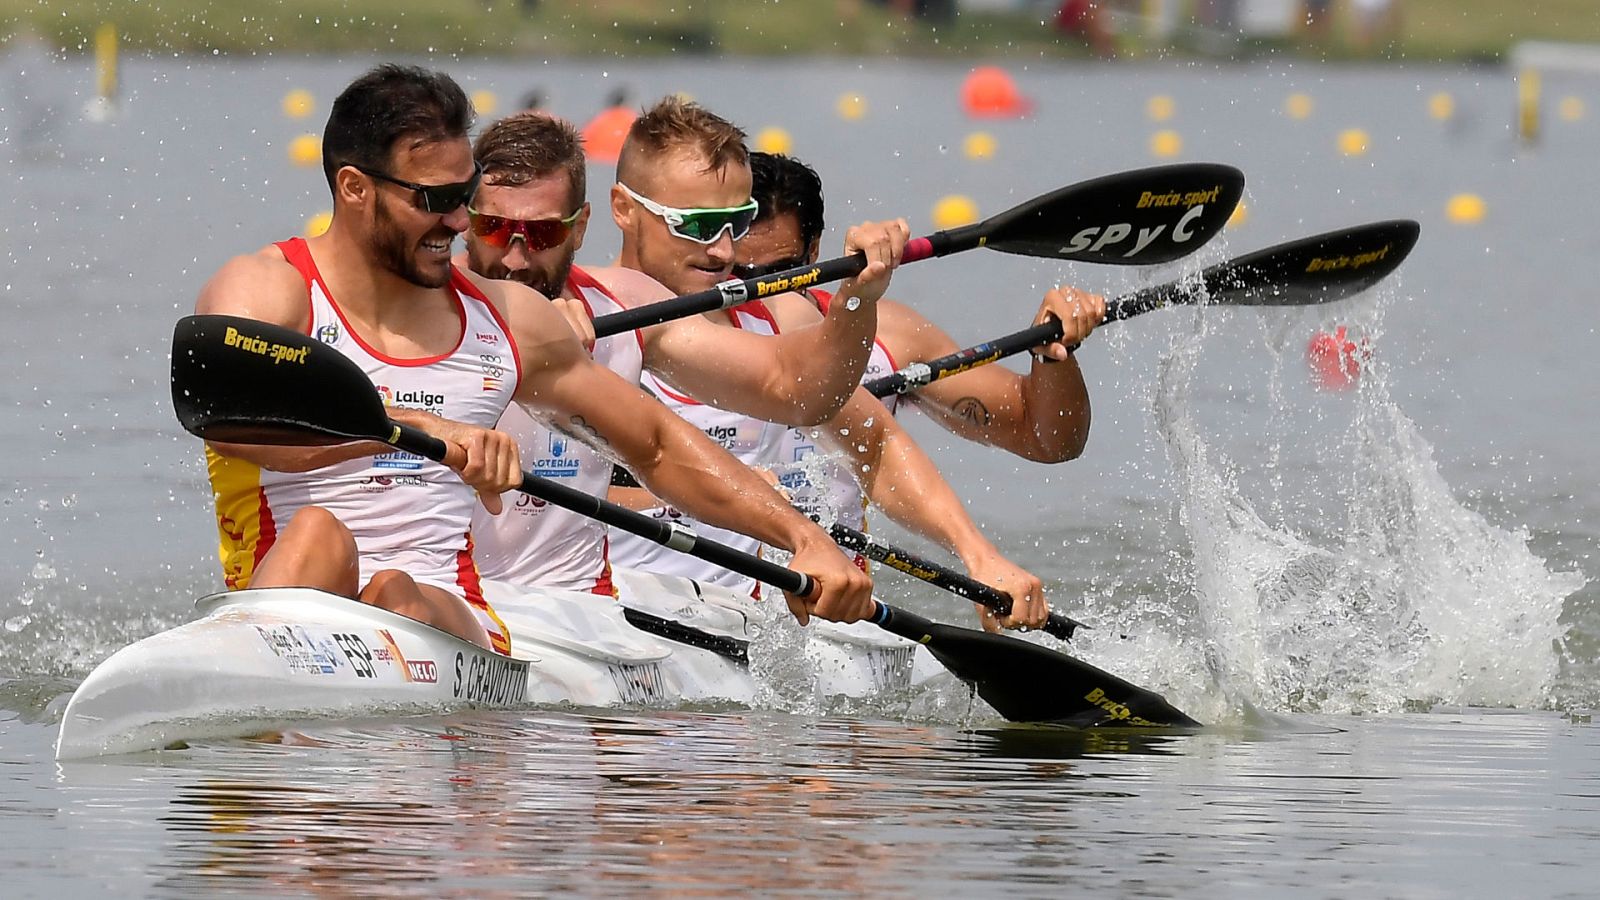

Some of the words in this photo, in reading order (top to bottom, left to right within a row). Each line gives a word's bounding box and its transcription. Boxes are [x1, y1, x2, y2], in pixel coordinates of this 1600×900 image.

[396, 391, 444, 406] LaLiga
[332, 633, 377, 678] ESP
[407, 662, 437, 681] NELO
[467, 655, 527, 706] CRAVIOTTO
